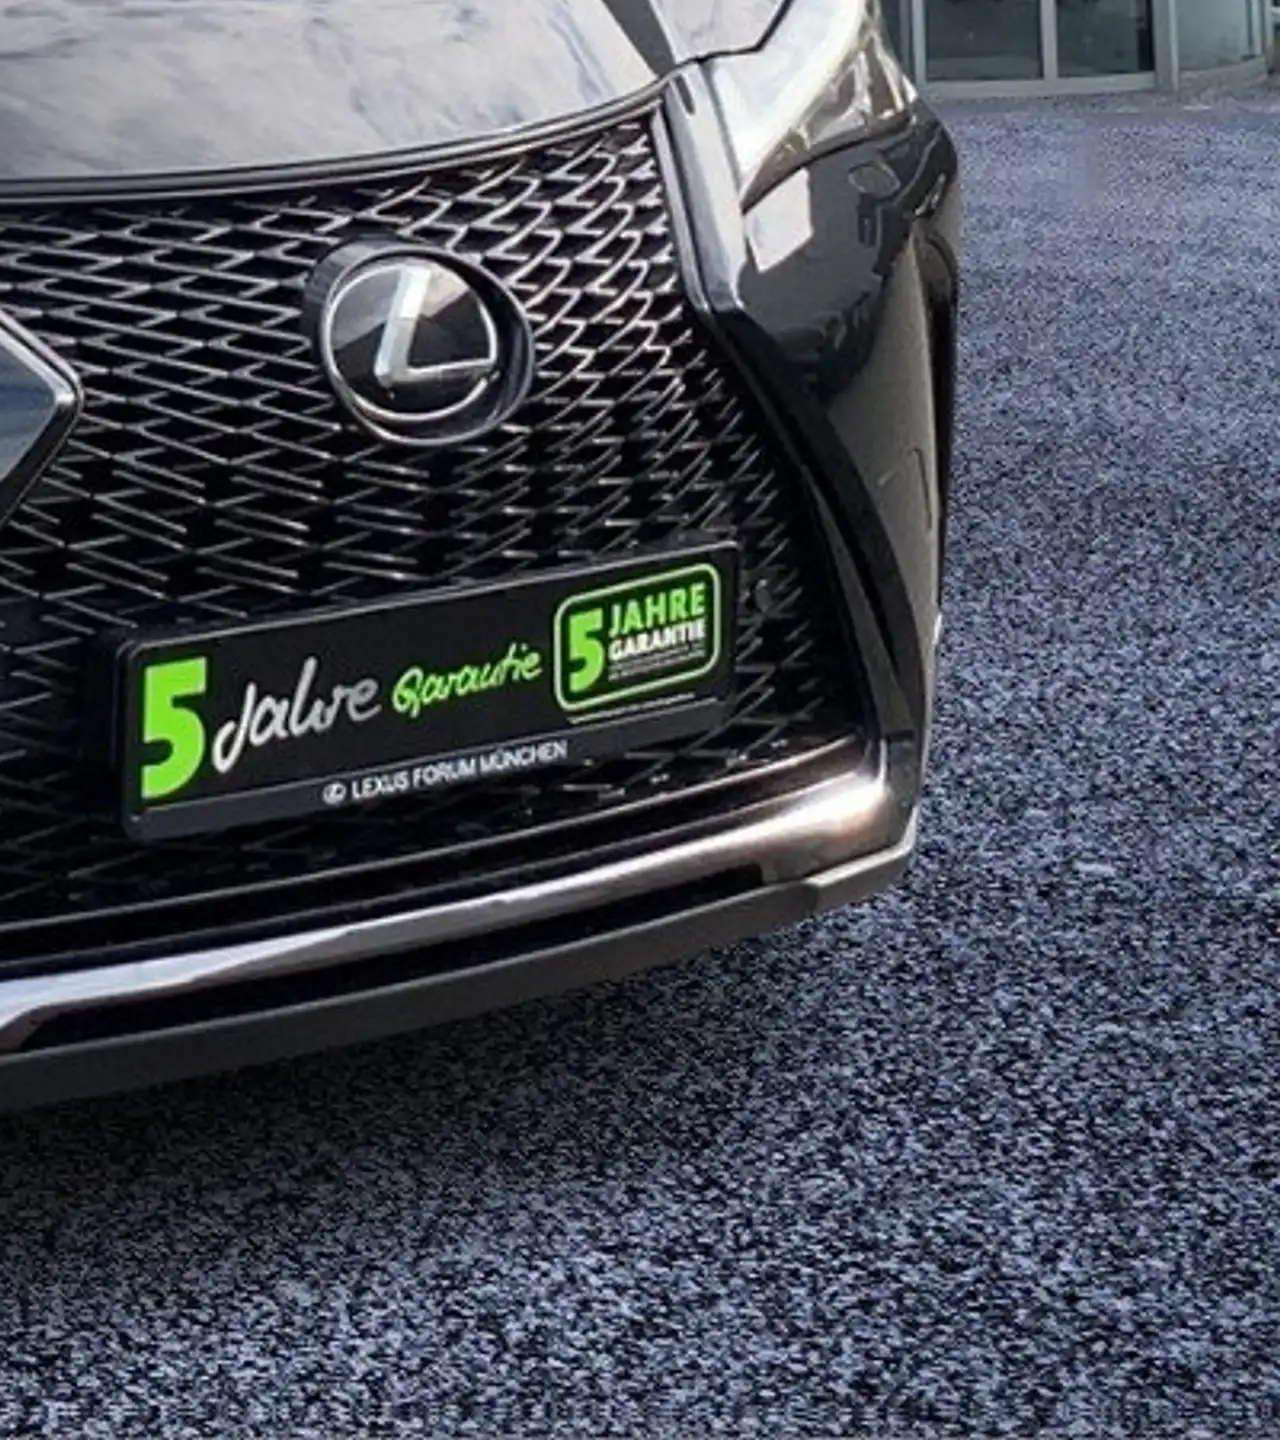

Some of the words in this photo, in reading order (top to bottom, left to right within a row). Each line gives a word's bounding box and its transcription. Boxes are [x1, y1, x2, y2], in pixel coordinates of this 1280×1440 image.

[569, 608, 605, 693] 5
[608, 581, 707, 638] JAHRE
[608, 616, 707, 662] GARANTIE
[141, 656, 207, 800] 5
[351, 770, 411, 801] LEXUS
[412, 756, 477, 788] FORUM
